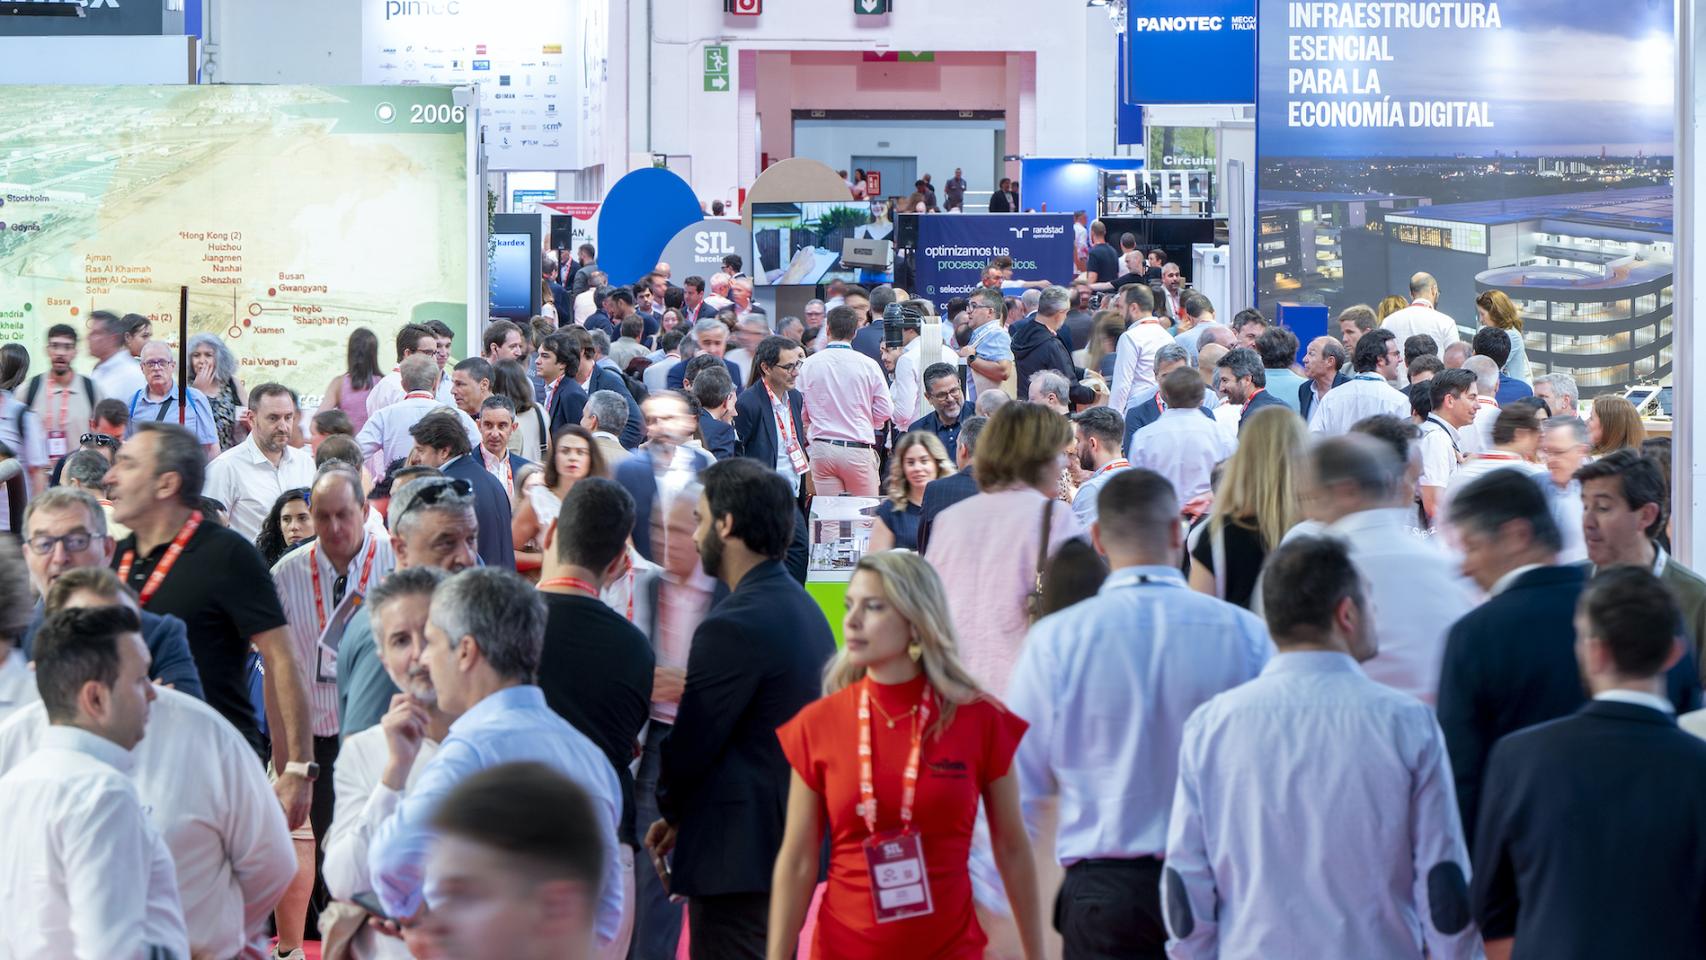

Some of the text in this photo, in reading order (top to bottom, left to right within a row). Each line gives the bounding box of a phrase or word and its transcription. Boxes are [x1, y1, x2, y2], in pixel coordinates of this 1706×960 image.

[386, 0, 460, 20] pimec
[1288, 2, 1502, 29] INFRAESTRUCTURA
[1137, 16, 1222, 32] PANOTEC
[1288, 35, 1394, 61] ESENCIAL
[1288, 68, 1381, 94] PARA LA
[410, 104, 465, 124] 2006
[1288, 95, 1494, 128] ECONOMÍA DIGITAL
[7, 194, 50, 202] Stockholm
[571, 228, 585, 237] AN
[1032, 225, 1064, 234] randstad
[206, 232, 228, 241] Kong
[230, 231, 242, 241] (2)
[208, 243, 242, 251] Huizhou
[497, 239, 525, 247] kardex
[694, 231, 735, 254] SIL
[925, 245, 1010, 258] optimizamos tus
[86, 254, 111, 263] Ajman
[202, 254, 242, 263] Jiangmen
[694, 255, 723, 264] Barcelo
[213, 264, 242, 272] Nanhai
[938, 257, 1038, 271] procesos lticos.
[86, 265, 152, 273] Ras Al Khaimah
[86, 276, 107, 284] Umm
[200, 276, 242, 284] Shenzhen
[279, 272, 305, 280] Busan
[86, 286, 110, 294] Sohar
[278, 284, 328, 293] Gwangyang
[47, 298, 71, 306] Basra
[293, 304, 322, 314] Ningbo
[161, 313, 172, 323] (2)
[337, 316, 349, 326] (2)
[253, 326, 285, 334] Xiamen
[11, 331, 24, 340] Qir
[257, 358, 279, 368] Vung
[281, 358, 298, 366] Tau
